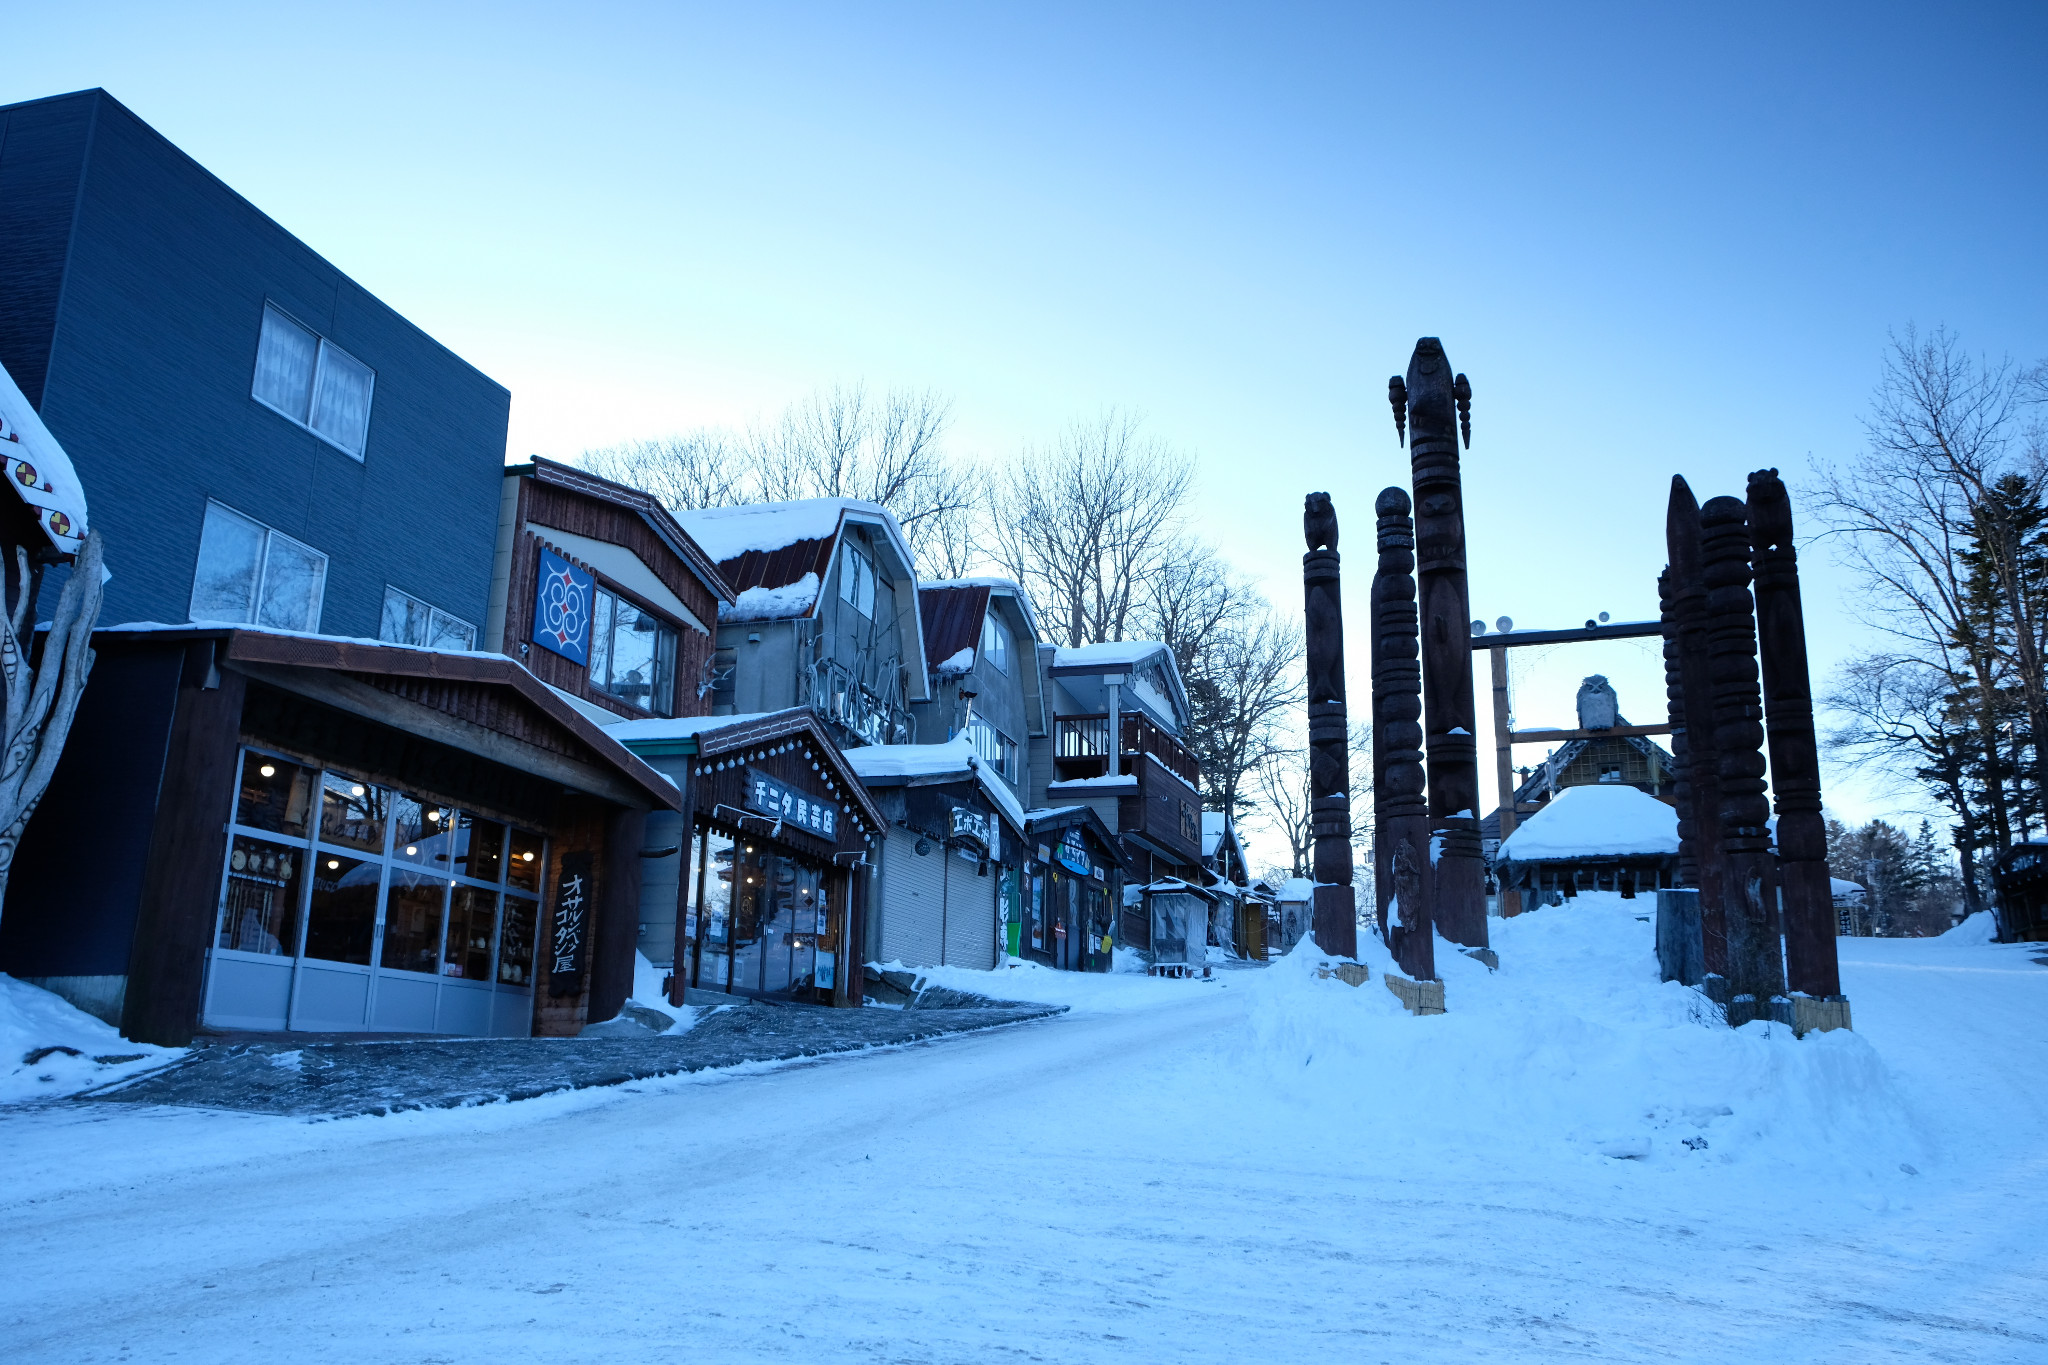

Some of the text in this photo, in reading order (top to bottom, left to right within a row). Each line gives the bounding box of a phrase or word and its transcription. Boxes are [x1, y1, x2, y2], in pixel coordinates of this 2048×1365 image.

[755, 781, 833, 834] チニタ民芸店
[953, 814, 989, 845] エポエポ
[551, 909, 576, 974] コタン屋
